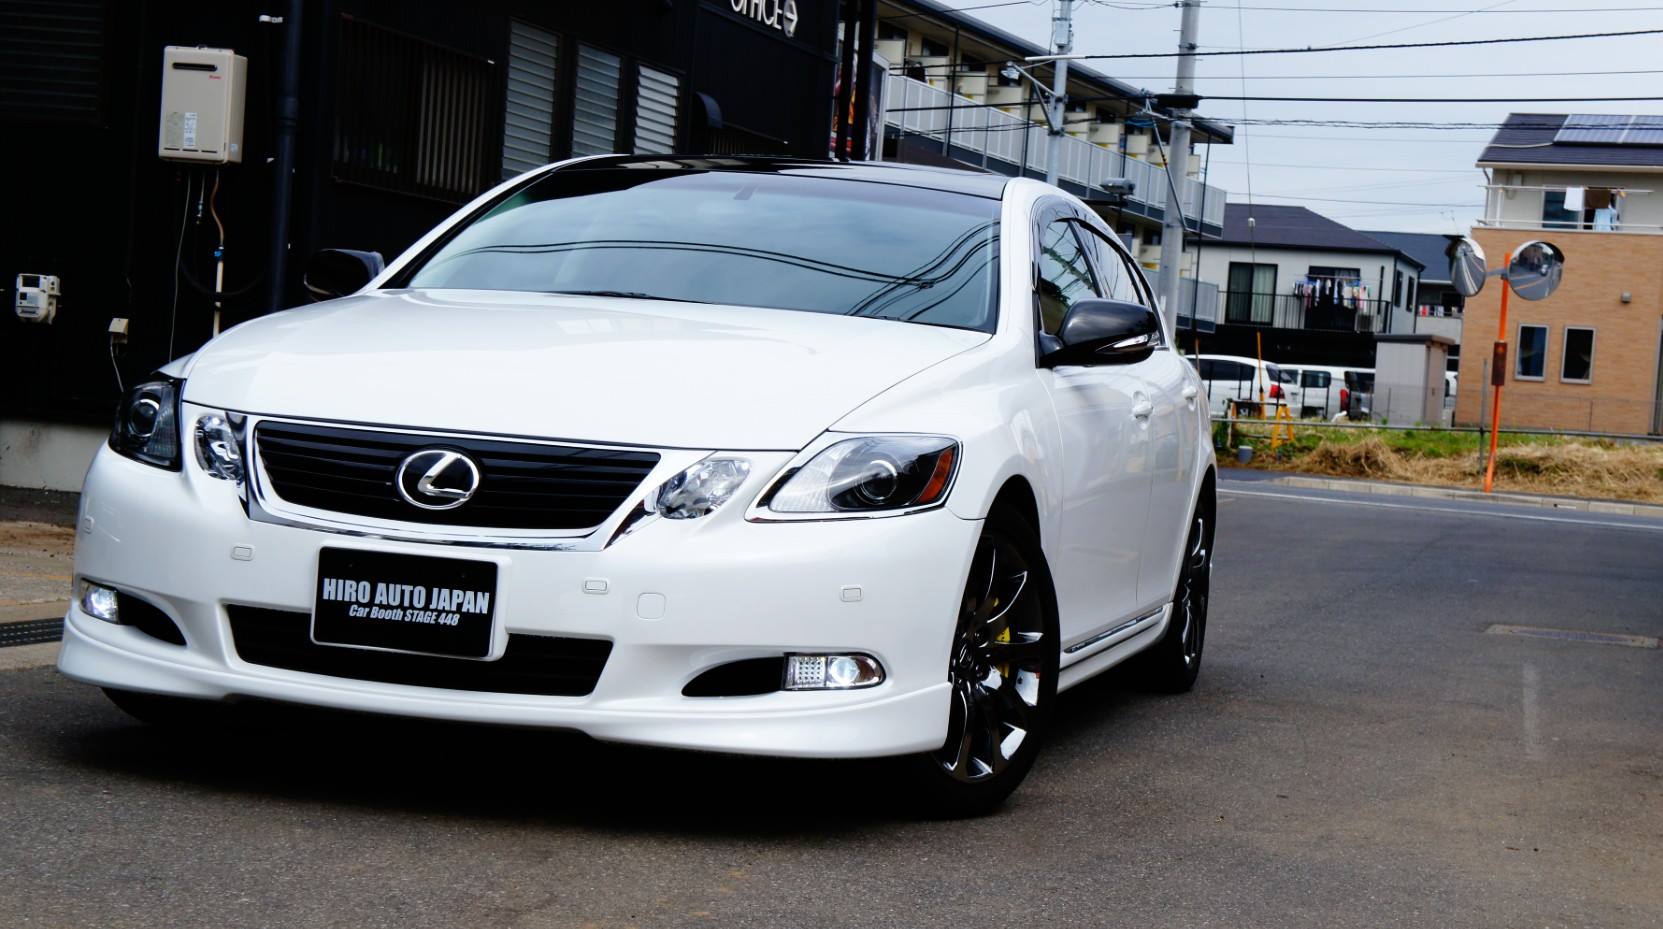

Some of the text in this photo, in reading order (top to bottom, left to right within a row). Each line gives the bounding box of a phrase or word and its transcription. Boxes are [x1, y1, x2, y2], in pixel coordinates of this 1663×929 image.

[322, 578, 490, 614] HIRO AUTO JAPAN
[349, 604, 461, 626] Car Booth STAGE 448
